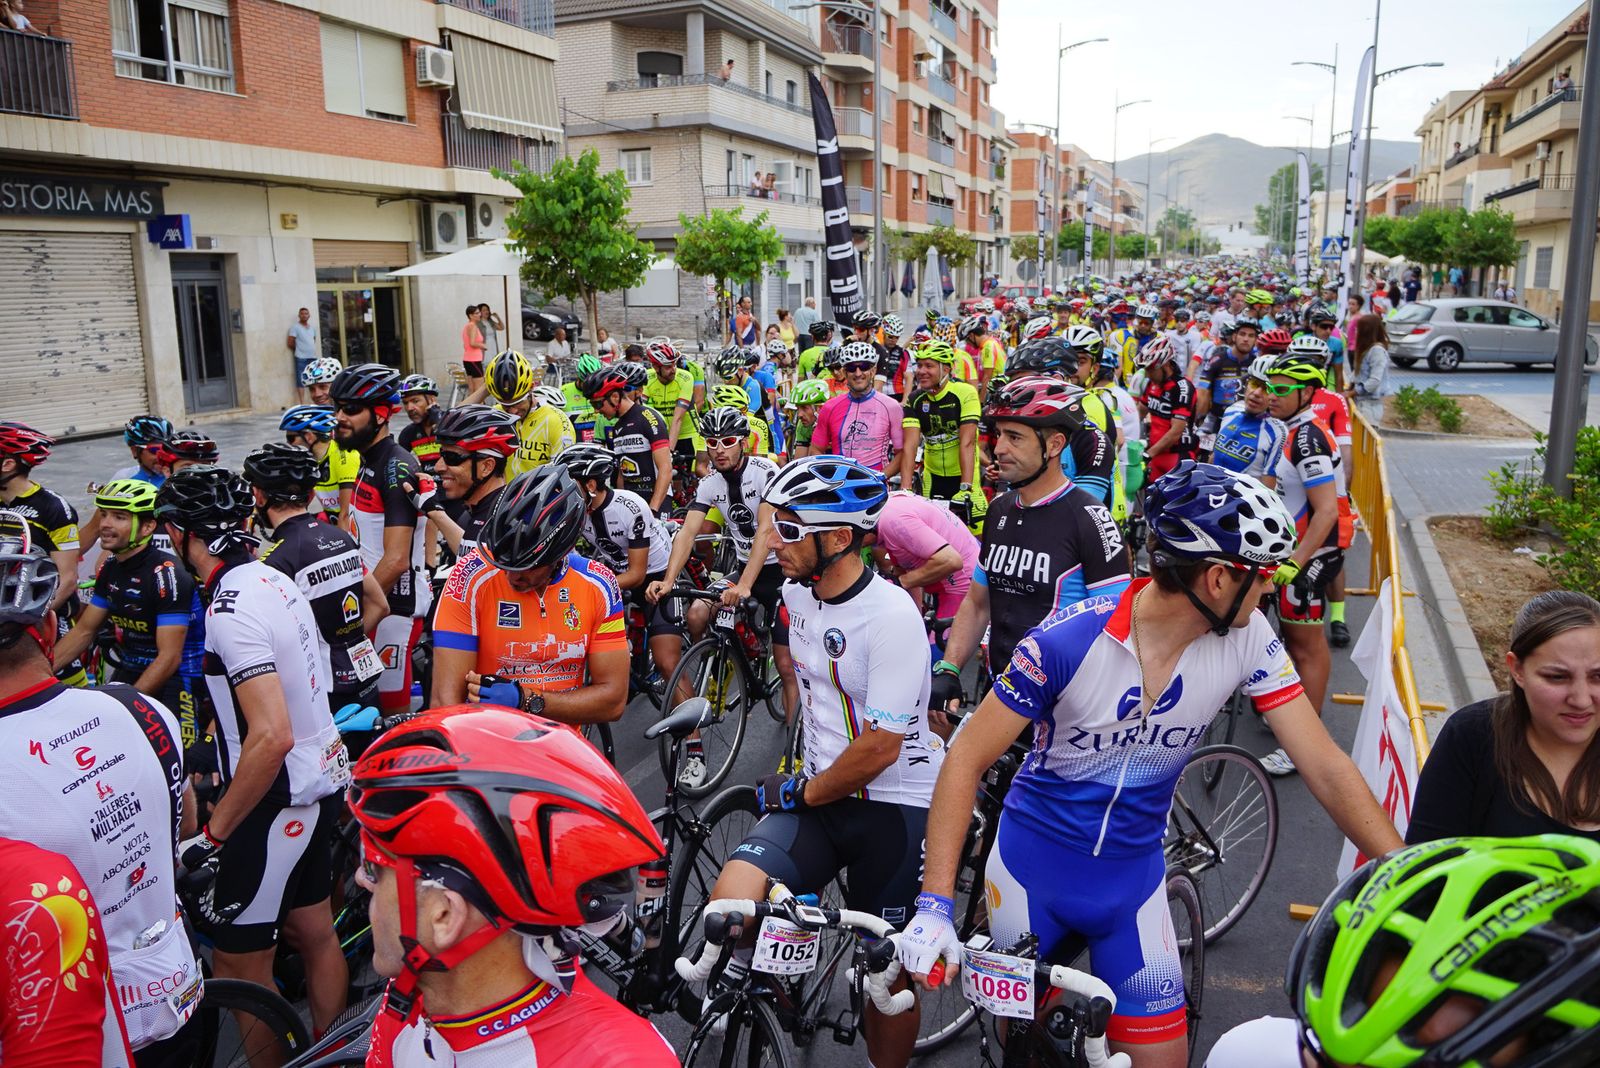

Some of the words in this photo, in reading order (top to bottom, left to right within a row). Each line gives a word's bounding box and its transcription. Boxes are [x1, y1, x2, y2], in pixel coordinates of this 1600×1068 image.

[104, 189, 153, 215] MAS
[162, 228, 182, 242] AXA
[1084, 504, 1124, 563] ASTRA
[984, 543, 1051, 584] JOYPA
[990, 575, 1036, 593] CYCLING
[242, 664, 276, 677] MEDICAL
[357, 657, 373, 671] 813
[48, 716, 101, 751] SPECIALIZED
[180, 690, 195, 749] SEMAR
[1067, 723, 1206, 752] ZURICH
[62, 752, 127, 795] cannondale
[360, 751, 473, 774] S-WORKS
[90, 798, 143, 843] MULHACEN
[94, 792, 131, 824] TALLERES
[123, 831, 149, 855] MOTA
[101, 842, 151, 883] ABOGADOS
[103, 892, 132, 916] GRUAS
[130, 876, 159, 900] JALDO
[769, 941, 815, 961] 1052
[971, 972, 1028, 1002] 1086
